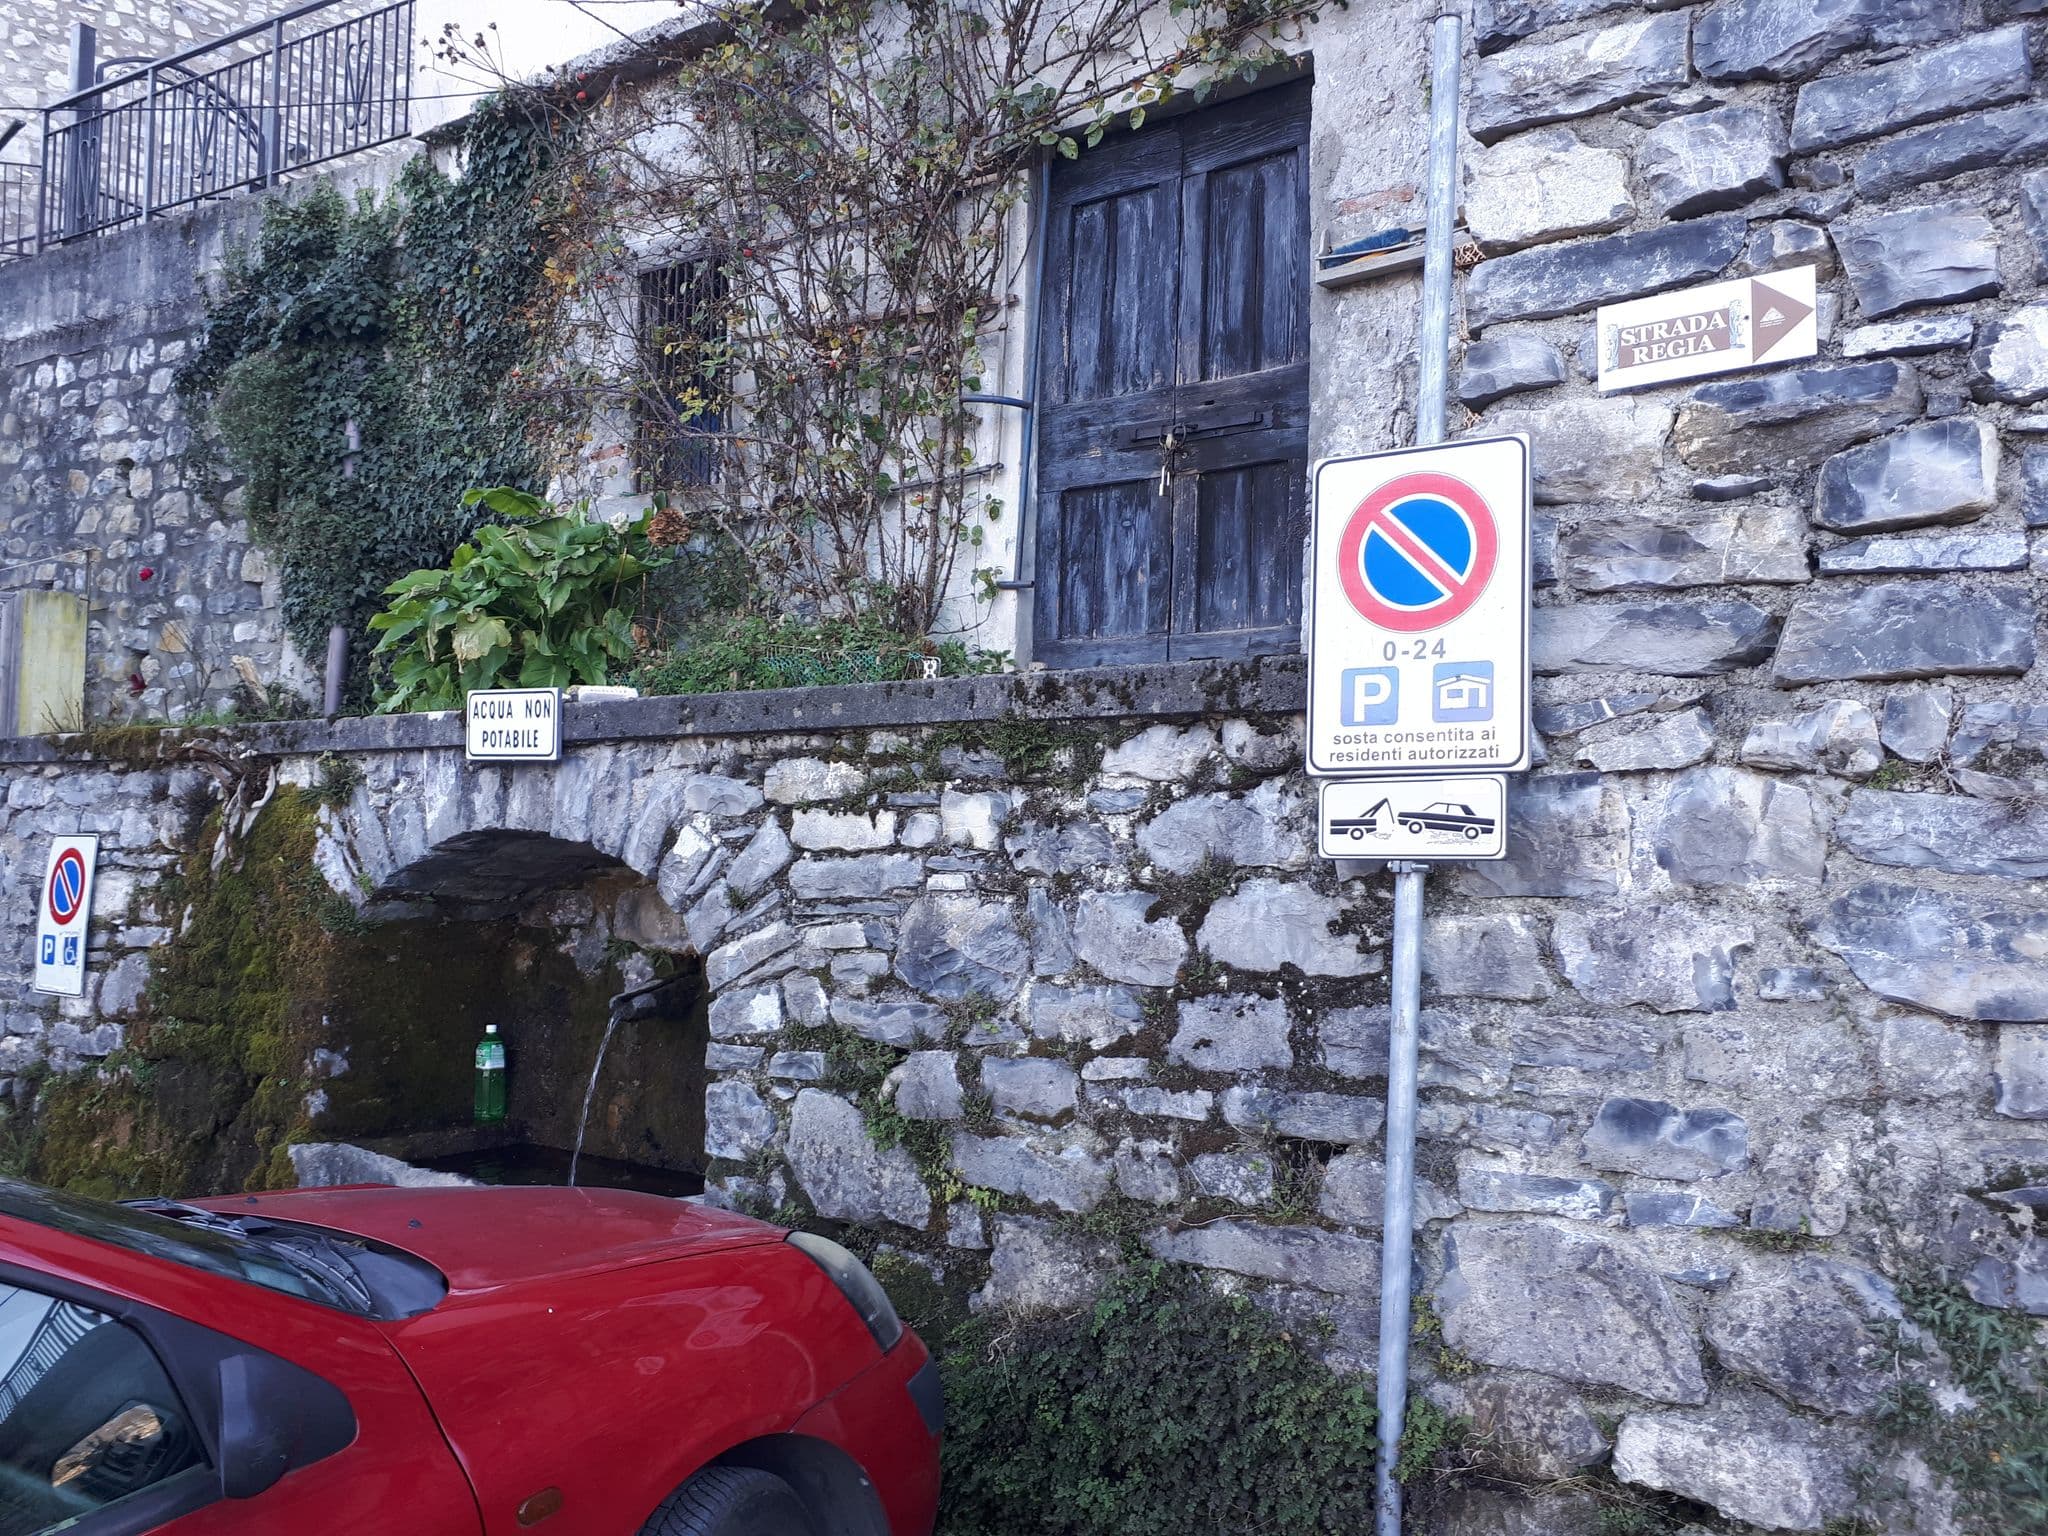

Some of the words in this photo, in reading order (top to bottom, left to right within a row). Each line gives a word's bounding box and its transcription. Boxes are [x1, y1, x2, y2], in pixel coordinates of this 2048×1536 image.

[1620, 311, 1727, 346] STRADA
[1632, 334, 1716, 365] REGIA
[1382, 638, 1446, 661] 0-24
[473, 700, 513, 719] ACQUA
[525, 699, 550, 718] NON
[1353, 673, 1392, 722] P
[482, 729, 539, 748] POTABILE
[1333, 730, 1378, 745] sosta
[1384, 727, 1474, 744] consentita
[1481, 726, 1496, 741] ai
[1329, 747, 1402, 762] residenti
[1408, 744, 1500, 760] autorizzati
[44, 938, 53, 961] P
